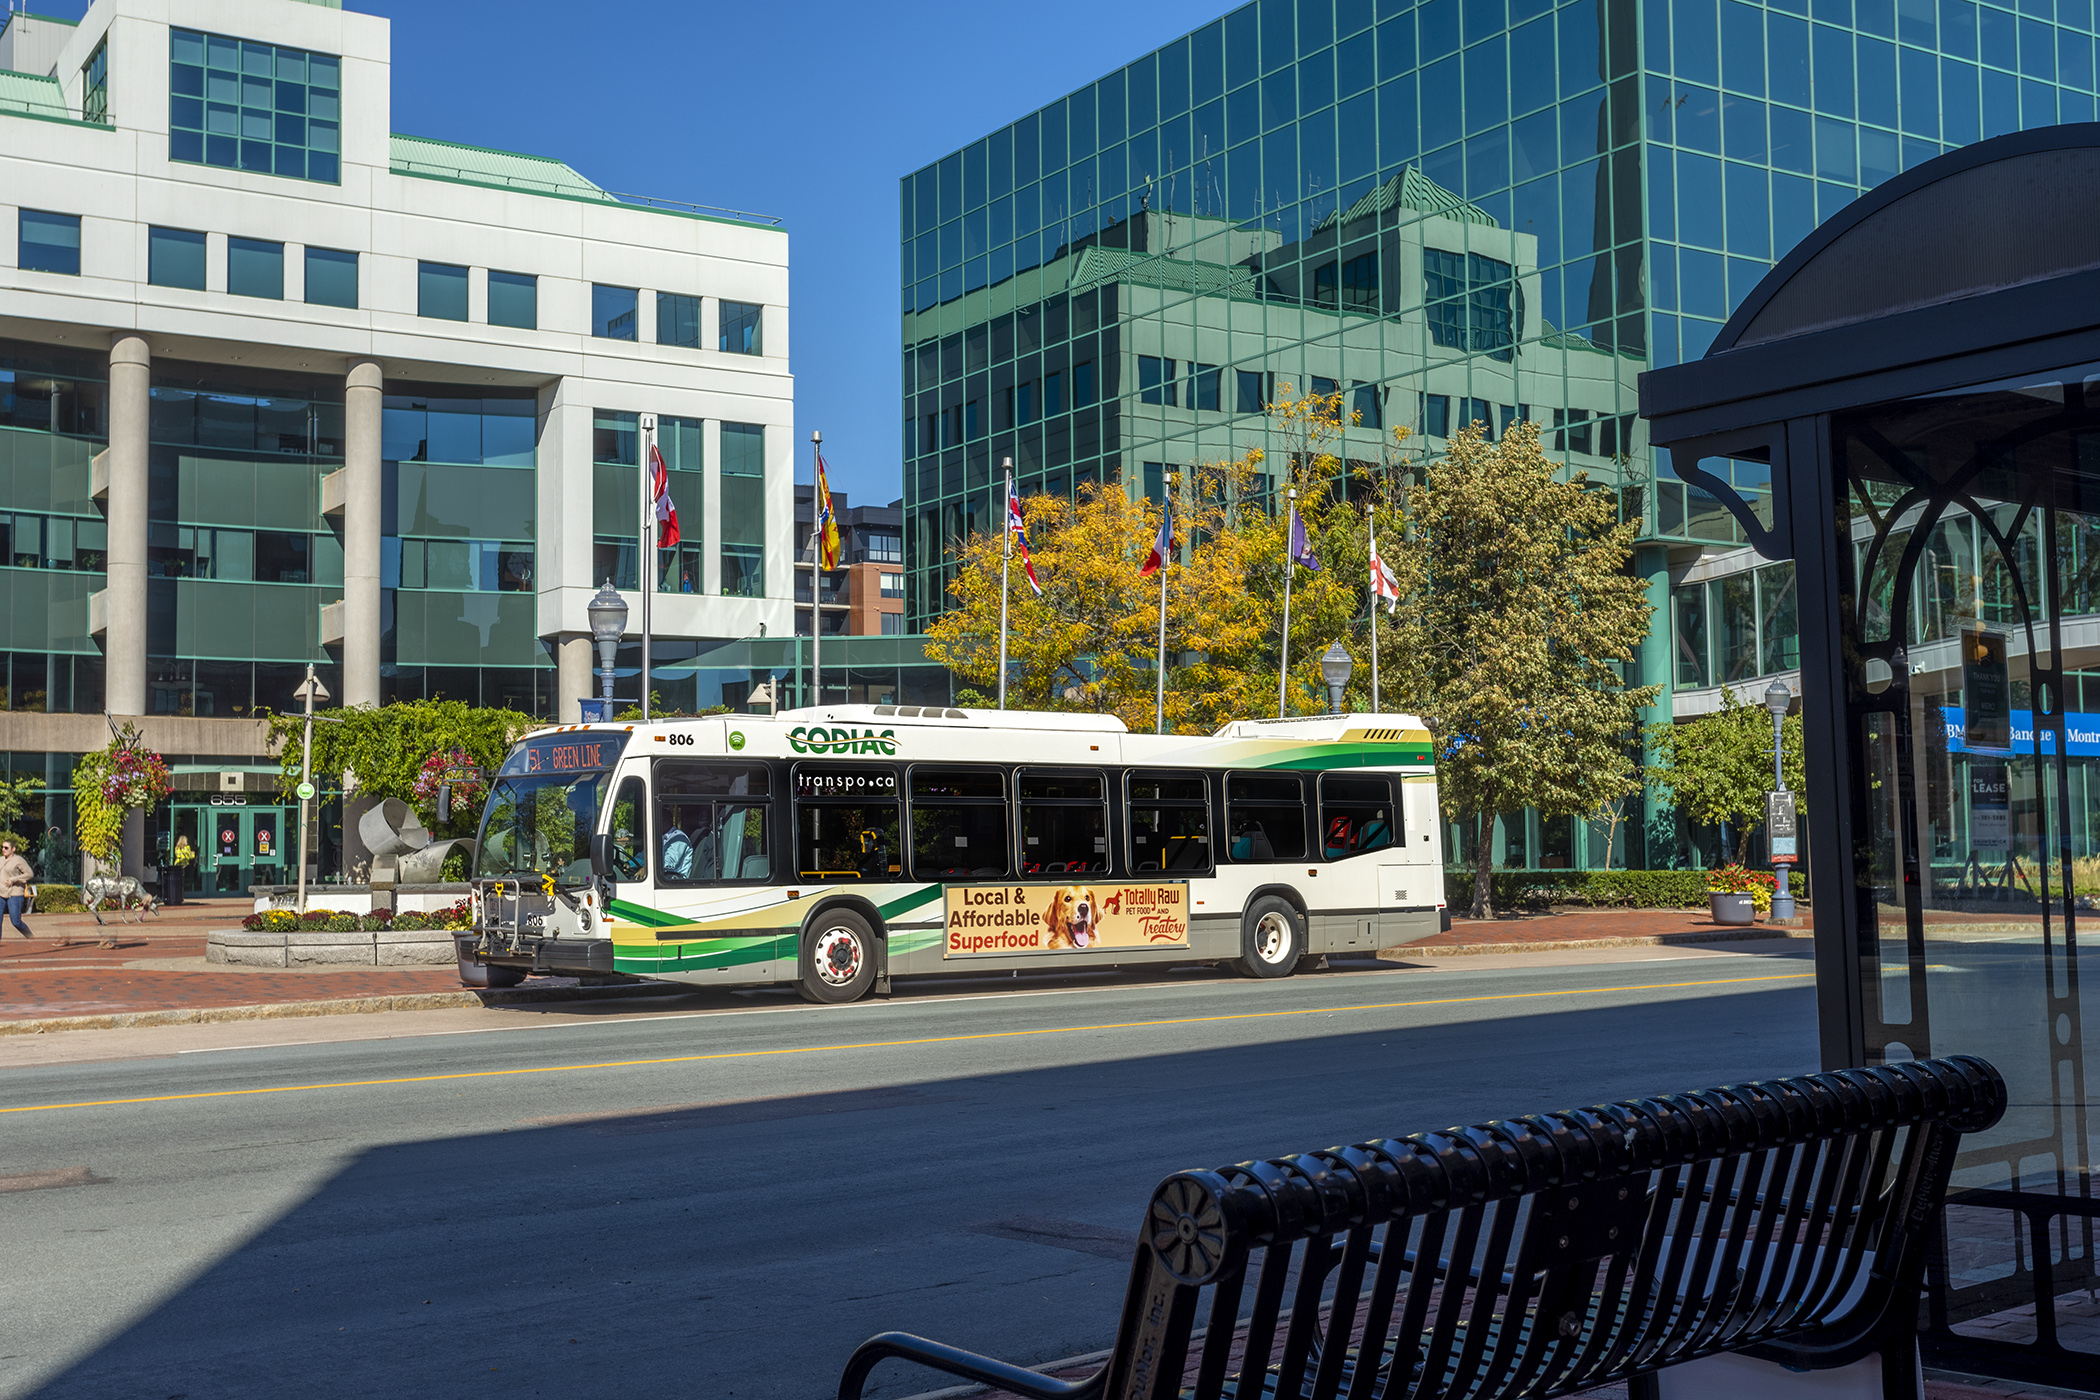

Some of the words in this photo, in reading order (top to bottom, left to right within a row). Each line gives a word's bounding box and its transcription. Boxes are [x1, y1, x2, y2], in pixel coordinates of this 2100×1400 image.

[669, 733, 694, 746] 806
[790, 726, 896, 756] CODIAC
[529, 748, 541, 770] 51
[552, 746, 579, 769] GREEN
[581, 744, 602, 768] LINE
[1973, 783, 2006, 793] LEASE
[210, 794, 247, 806] 655
[964, 888, 1009, 905] Local
[1014, 887, 1026, 905] &
[1123, 888, 1156, 911] Totally
[1157, 888, 1179, 904] Raw
[949, 909, 1040, 928] Affordable
[1126, 907, 1135, 915] PET
[1137, 907, 1150, 915] FOOD
[1138, 915, 1186, 943] Treatery
[949, 929, 1039, 953] Superfood
